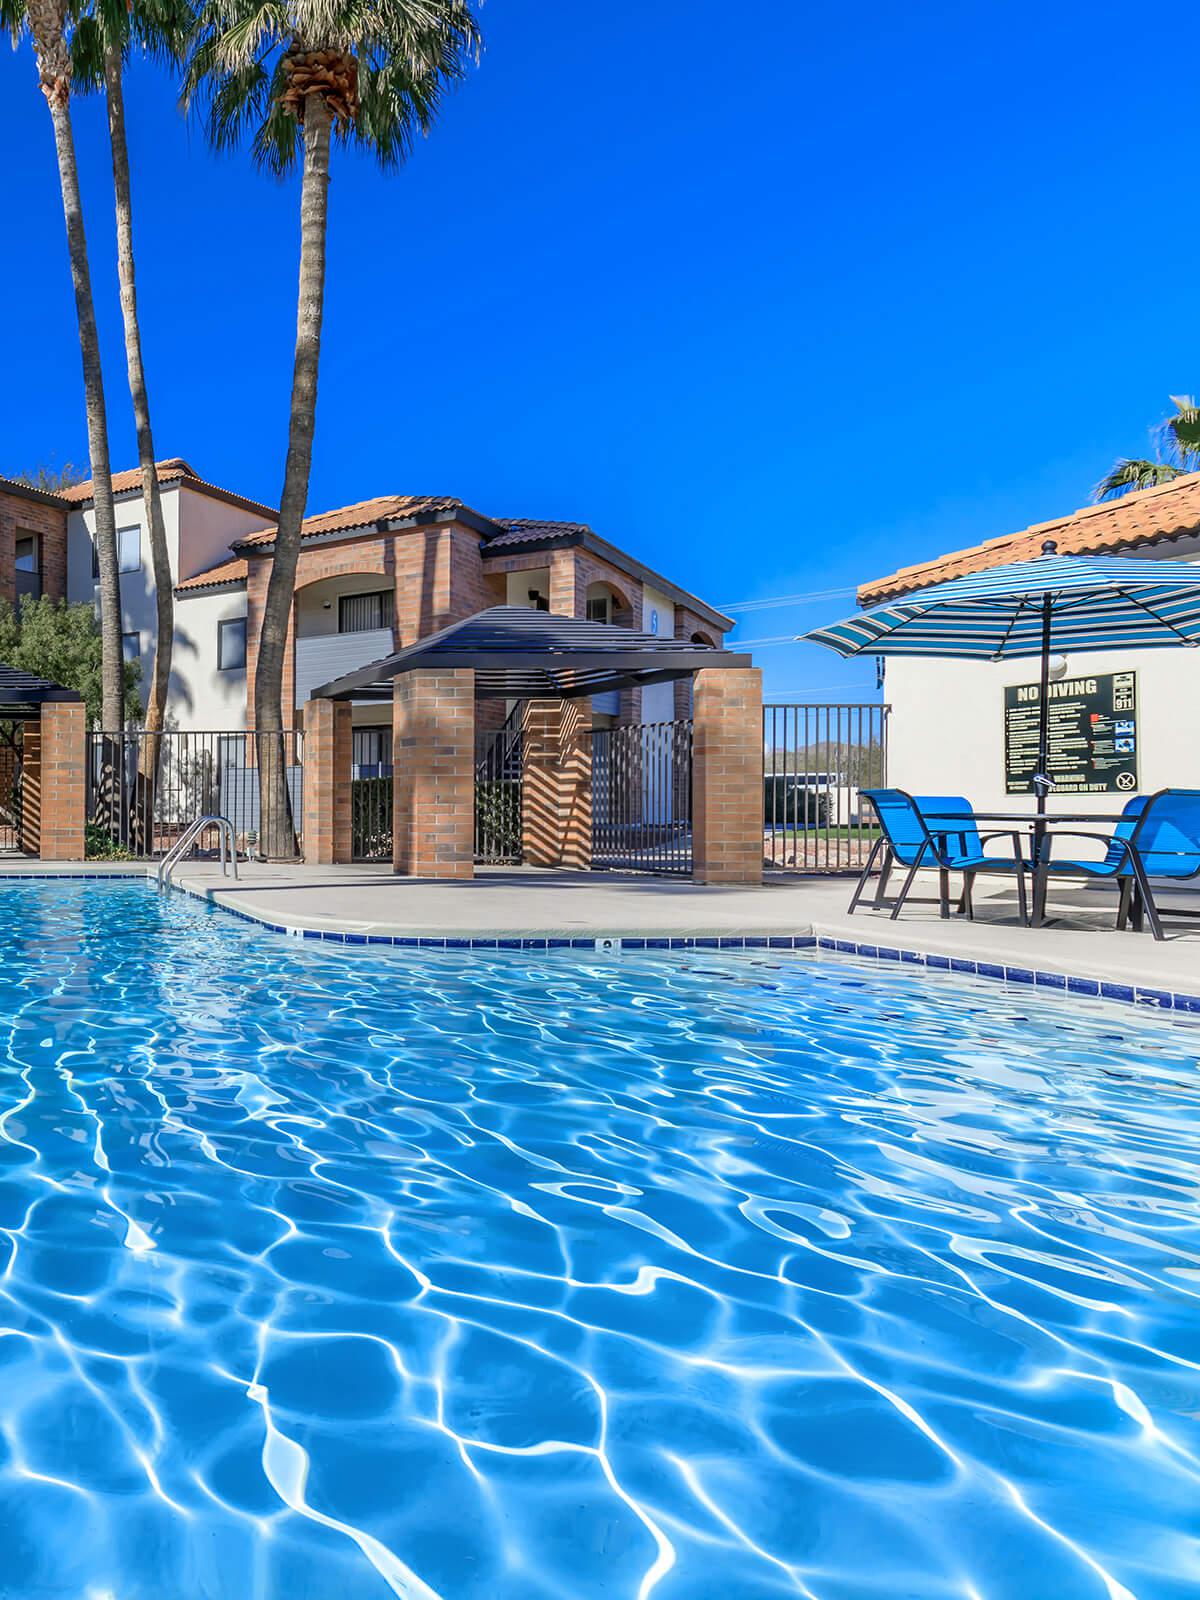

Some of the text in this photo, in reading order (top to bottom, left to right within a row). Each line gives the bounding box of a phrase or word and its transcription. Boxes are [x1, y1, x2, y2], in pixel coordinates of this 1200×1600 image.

[1017, 686, 1039, 702] NO
[1116, 698, 1132, 709] 911
[1089, 782, 1108, 792] DUTY
